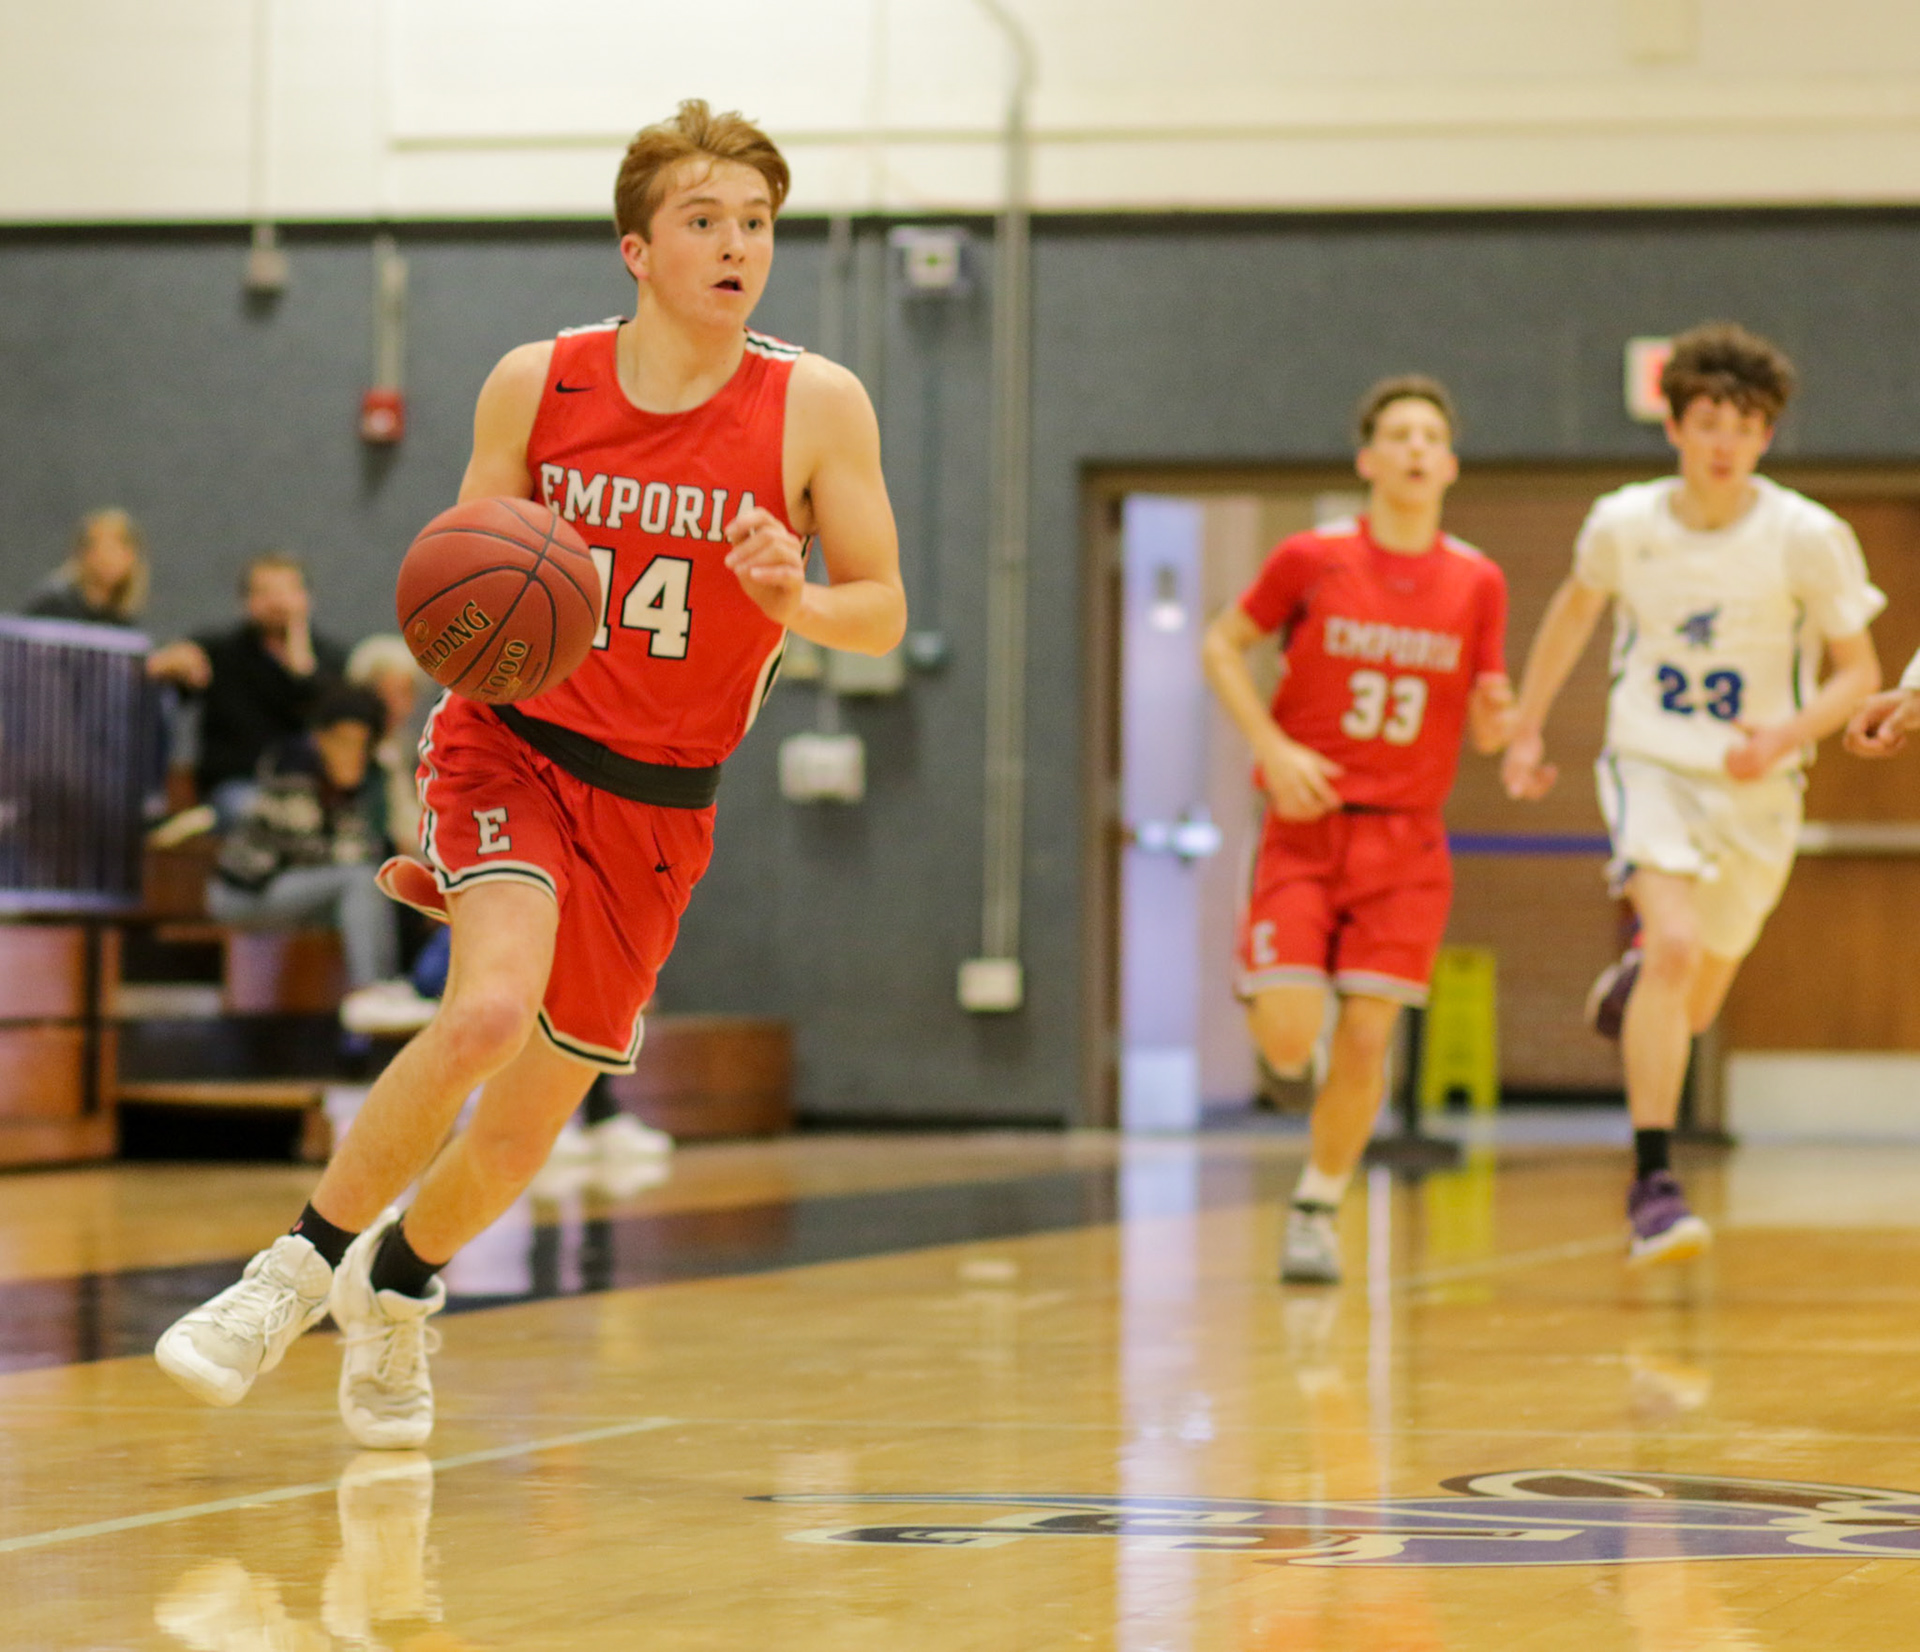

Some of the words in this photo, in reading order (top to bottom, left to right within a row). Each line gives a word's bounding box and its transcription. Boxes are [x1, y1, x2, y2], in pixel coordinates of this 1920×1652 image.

[588, 545, 693, 660] 14
[480, 640, 528, 697] 1000
[1657, 664, 1743, 720] 23
[1341, 669, 1428, 745] 33
[471, 806, 512, 856] E
